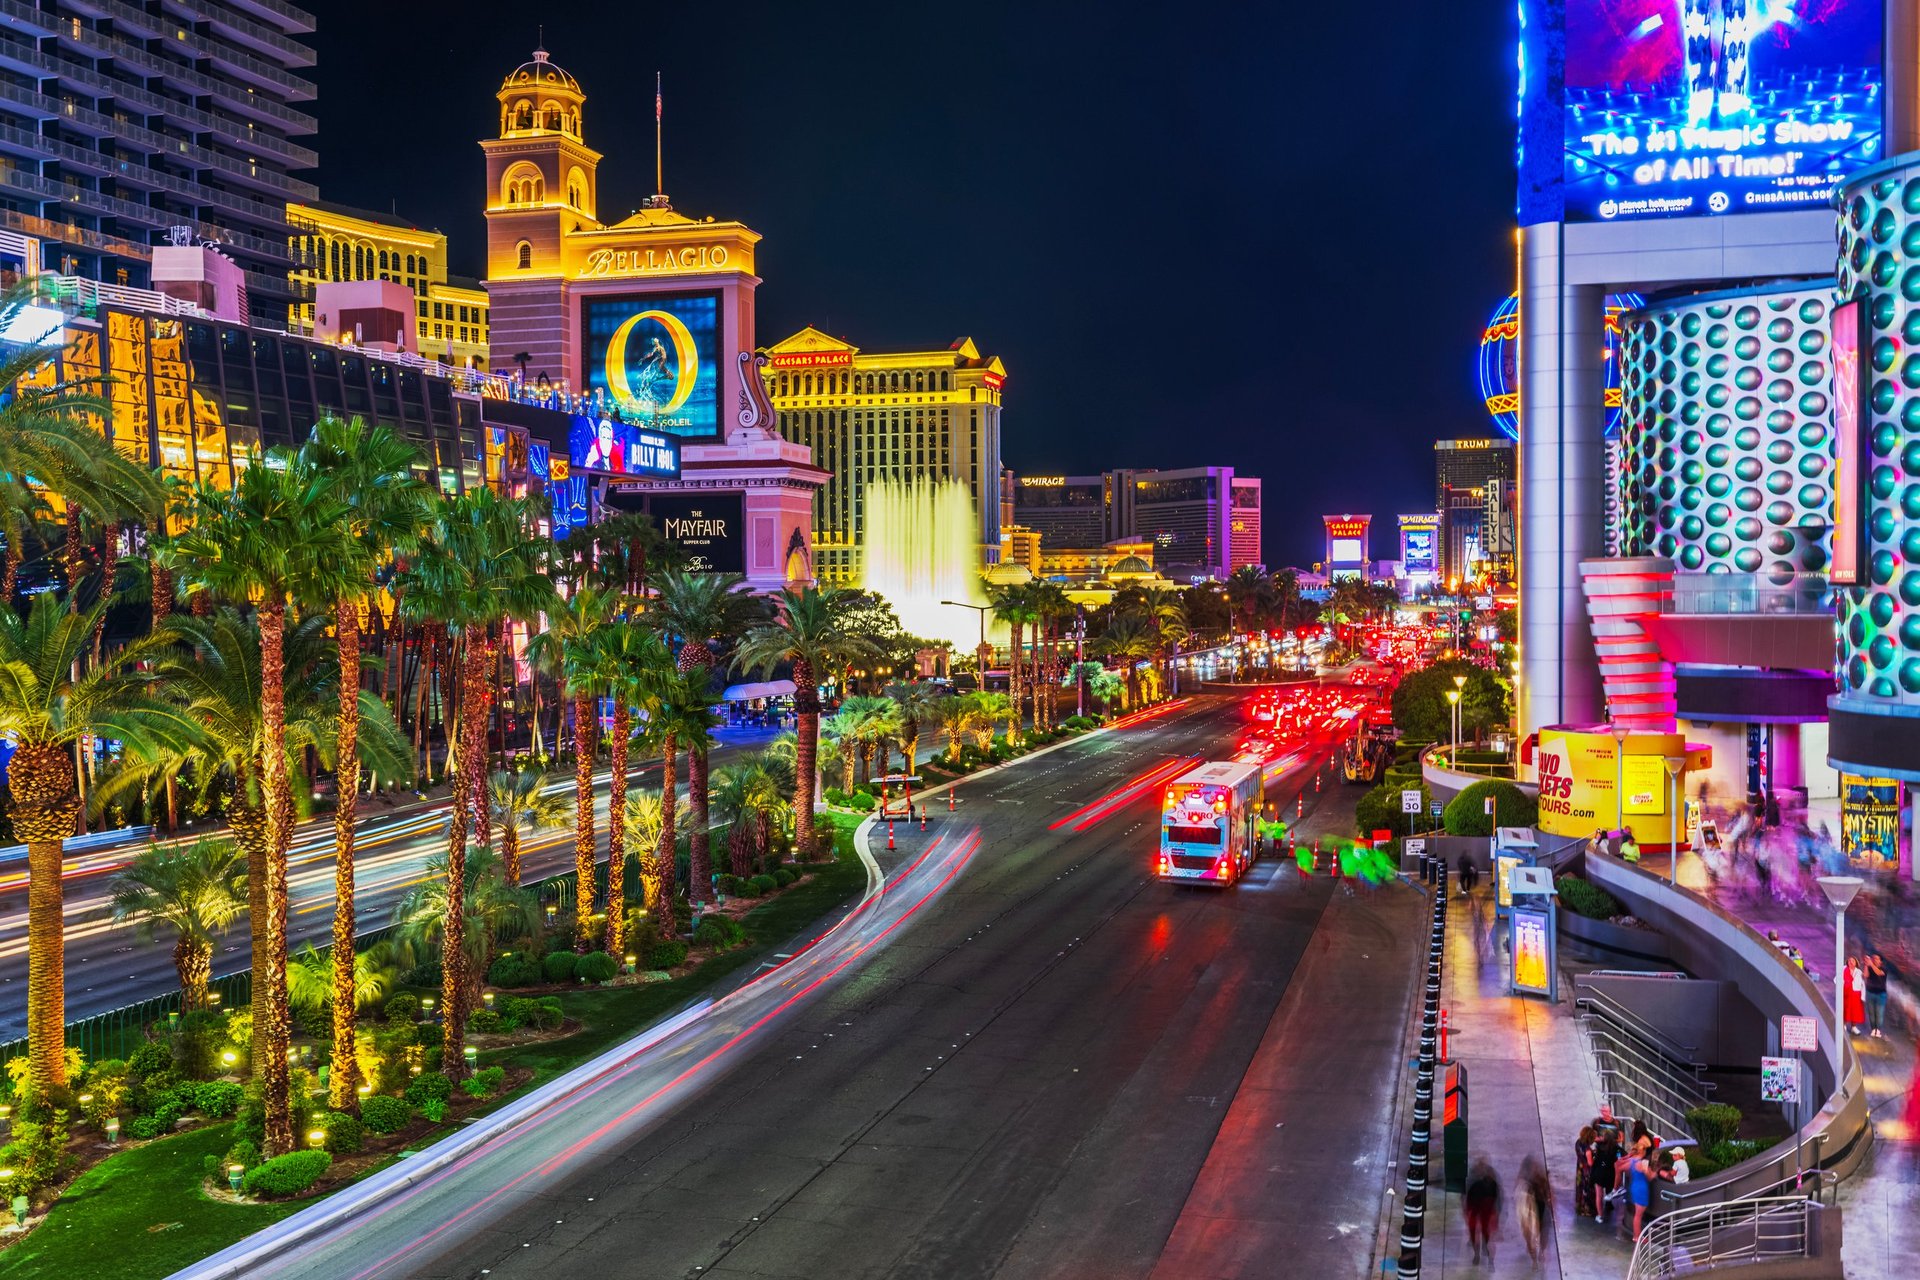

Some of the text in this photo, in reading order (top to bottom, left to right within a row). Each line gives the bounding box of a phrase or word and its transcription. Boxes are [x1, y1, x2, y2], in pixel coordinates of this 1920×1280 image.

[1647, 130, 1678, 152] #1
[1680, 123, 1767, 151] Magic
[1774, 119, 1853, 145] Show
[1634, 159, 1666, 184] of
[1672, 156, 1709, 181] All
[1777, 177, 1794, 186] Las
[1796, 175, 1826, 186] Vegas
[578, 245, 729, 276] BELLAGIO
[774, 354, 849, 366] CAESARS PALACE
[662, 418, 693, 427] SOLEIL
[1456, 439, 1490, 449] TRUMP
[631, 443, 655, 467] BILLY
[1026, 477, 1065, 487] MIRAGE
[1403, 516, 1439, 524] MIRAGE
[665, 518, 728, 539] MAYFAIR
[1405, 803, 1420, 811] 30
